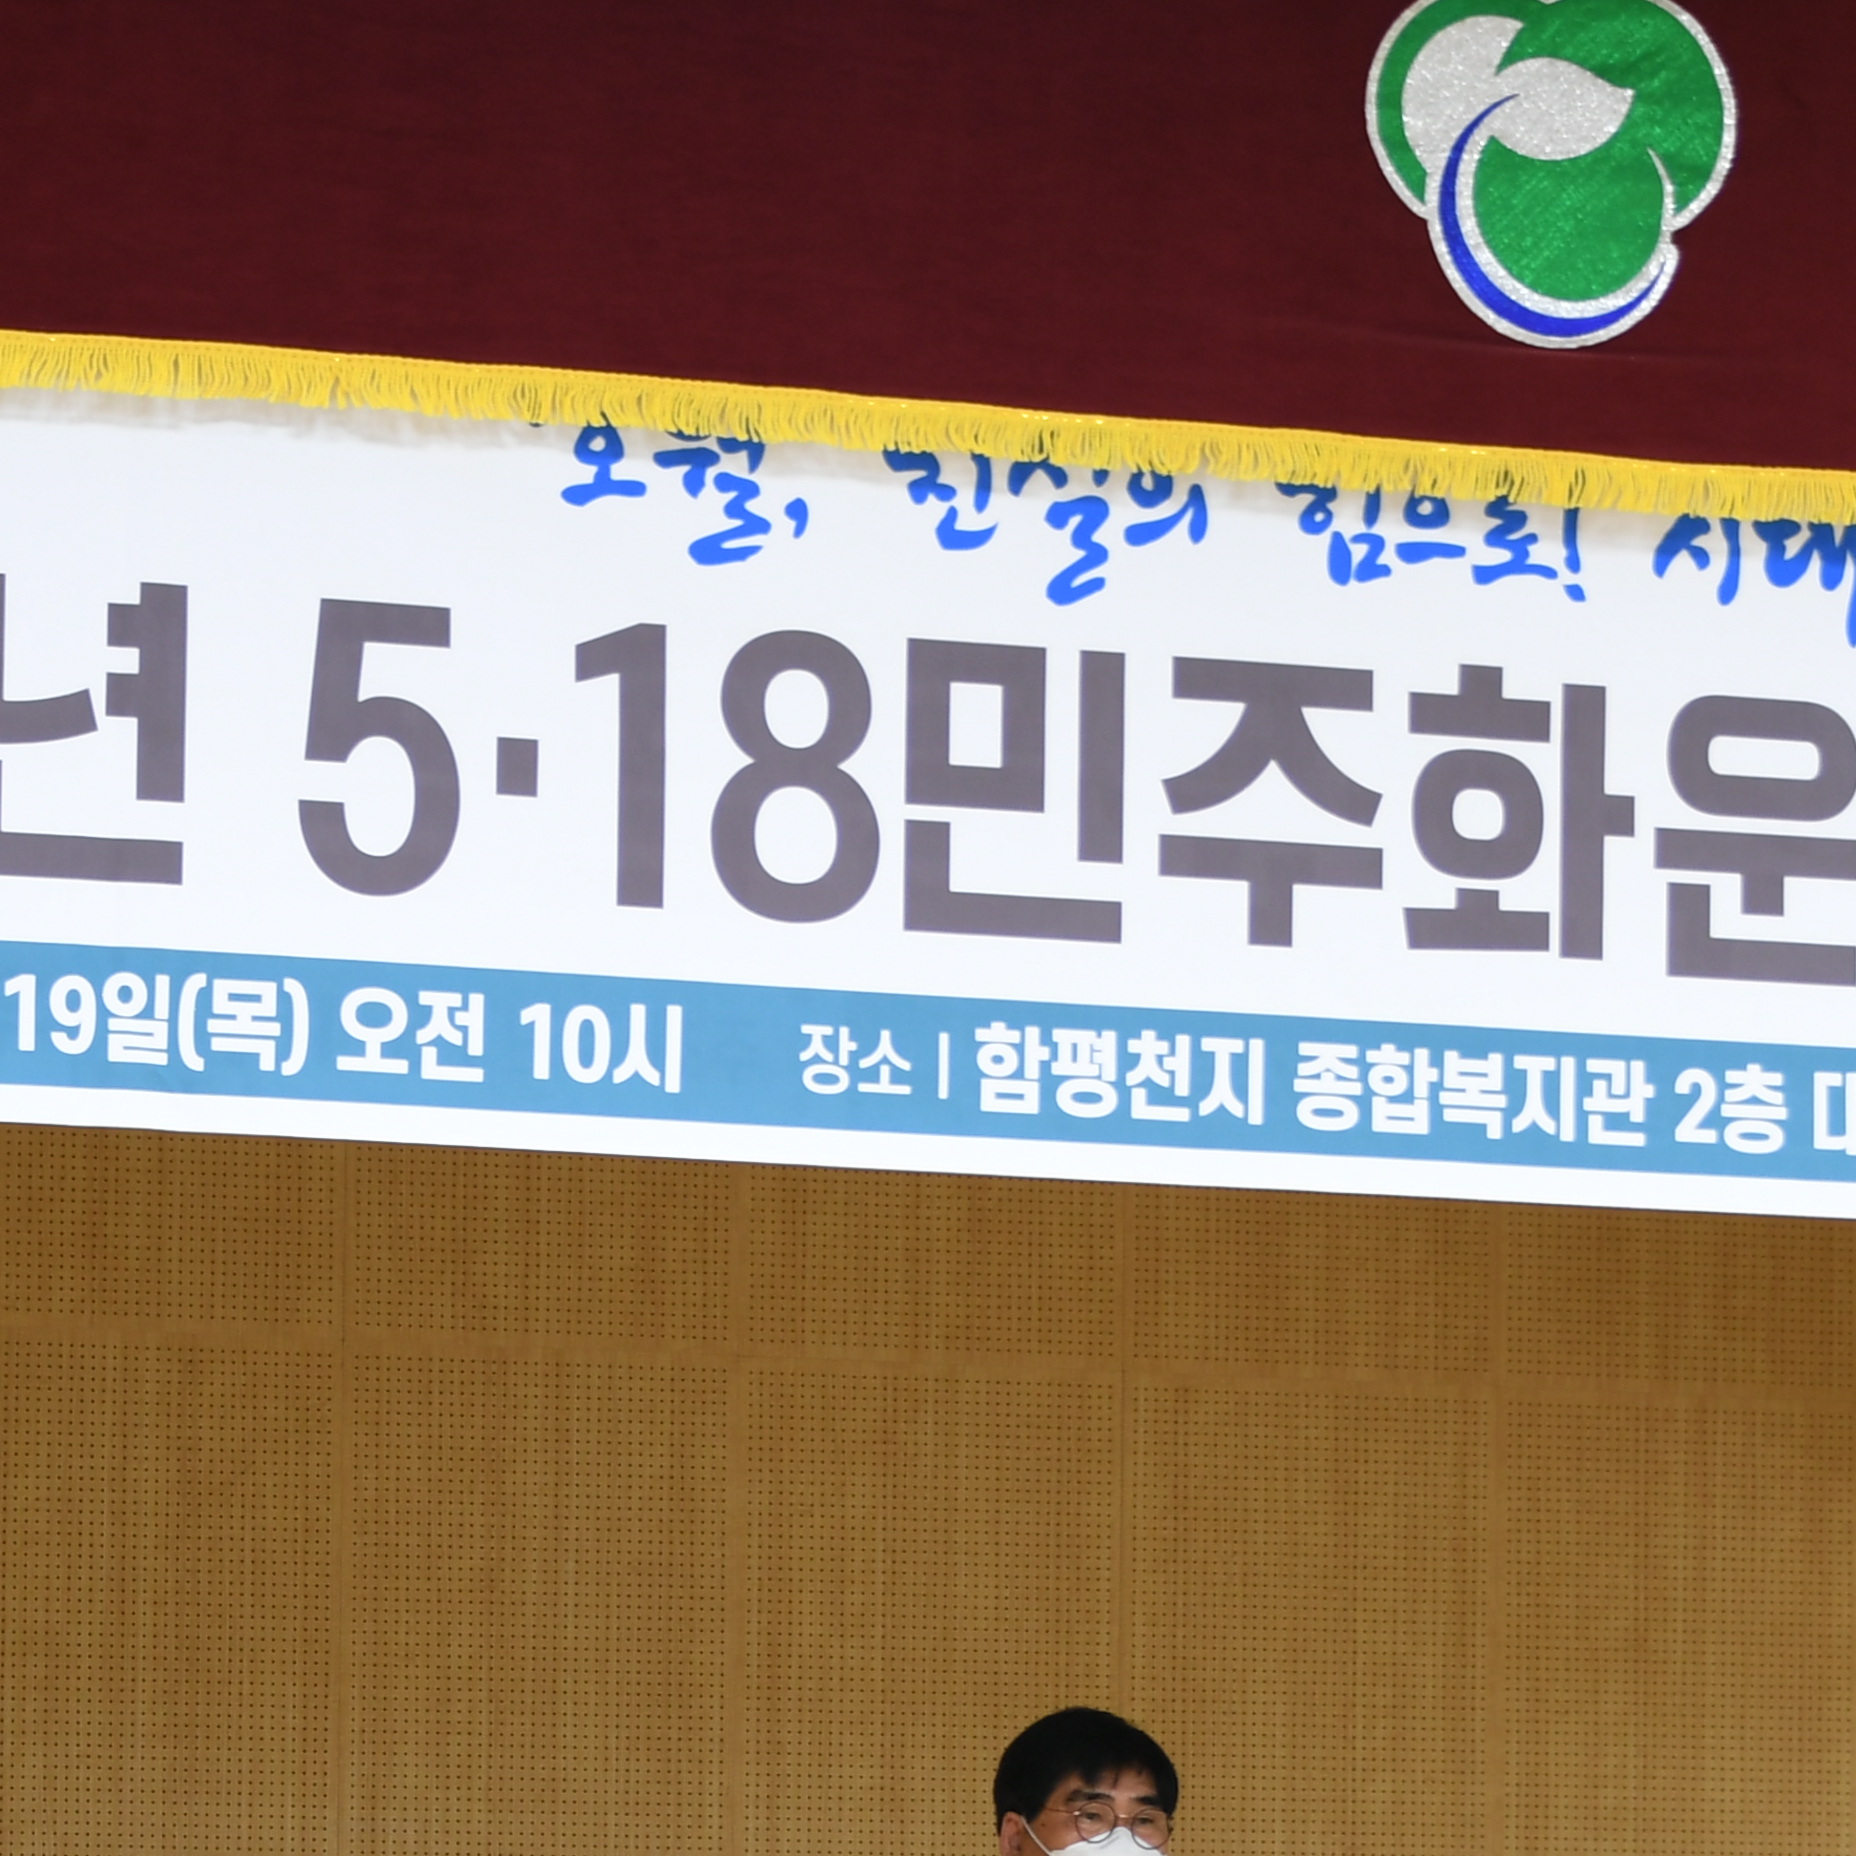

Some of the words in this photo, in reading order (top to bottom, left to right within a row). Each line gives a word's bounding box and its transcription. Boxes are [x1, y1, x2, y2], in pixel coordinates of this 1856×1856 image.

[6, 970, 311, 1076] 19일(목)
[336, 985, 486, 1083] 오전
[520, 1002, 684, 1094] 10시
[798, 1022, 913, 1096] 장소
[974, 1026, 1266, 1126] 함평천지
[1292, 1046, 1656, 1147] 종합복지관
[1673, 1063, 1790, 1155] 2층
